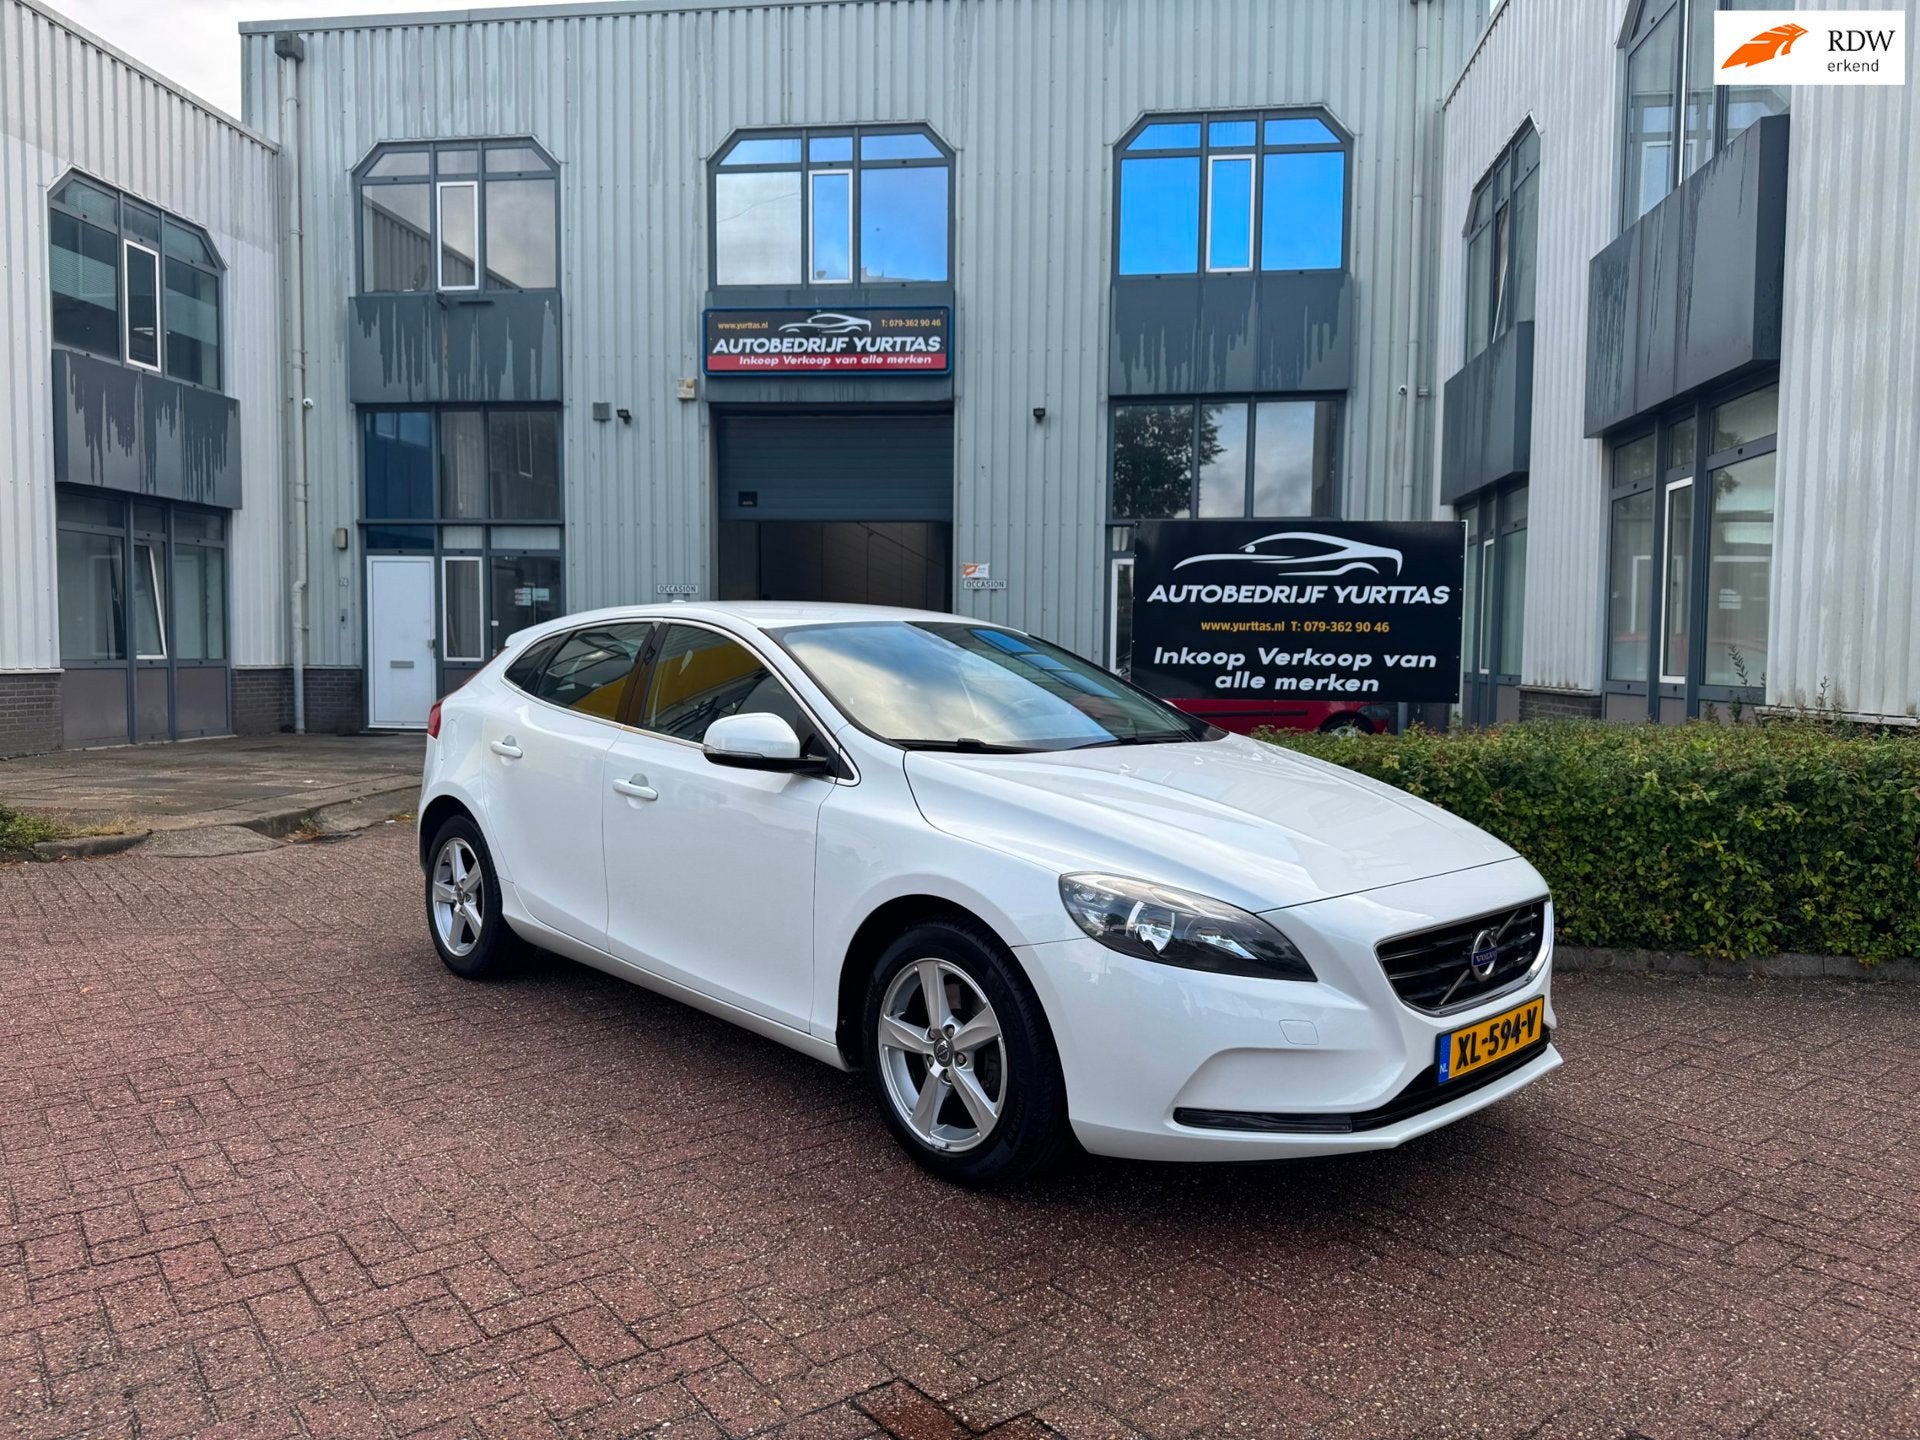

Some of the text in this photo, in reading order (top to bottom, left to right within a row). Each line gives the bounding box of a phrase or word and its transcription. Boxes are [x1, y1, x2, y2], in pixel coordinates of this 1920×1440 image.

[718, 321, 768, 330] www.yurttas.nl
[889, 319, 917, 327] 079-362
[918, 319, 930, 327] 90
[931, 319, 941, 327] 46
[712, 336, 941, 354] AUTOBEDRIJF YURTTAS
[739, 356, 779, 367] Inkoop
[783, 356, 831, 366] Verkoop
[861, 356, 883, 364] alle
[887, 356, 932, 364] merken
[659, 585, 696, 593] OCCASION
[1146, 584, 1450, 605] AUTOBEDRIJF YURTTAS
[1200, 621, 1390, 633] www.yurttas.nl T: 079-362 90 46
[1153, 647, 1437, 671] Inkoop Verkoop van
[1214, 671, 1379, 692] alle merken
[1456, 1006, 1538, 1071] XL-594-V
[1439, 1064, 1448, 1074] NL
